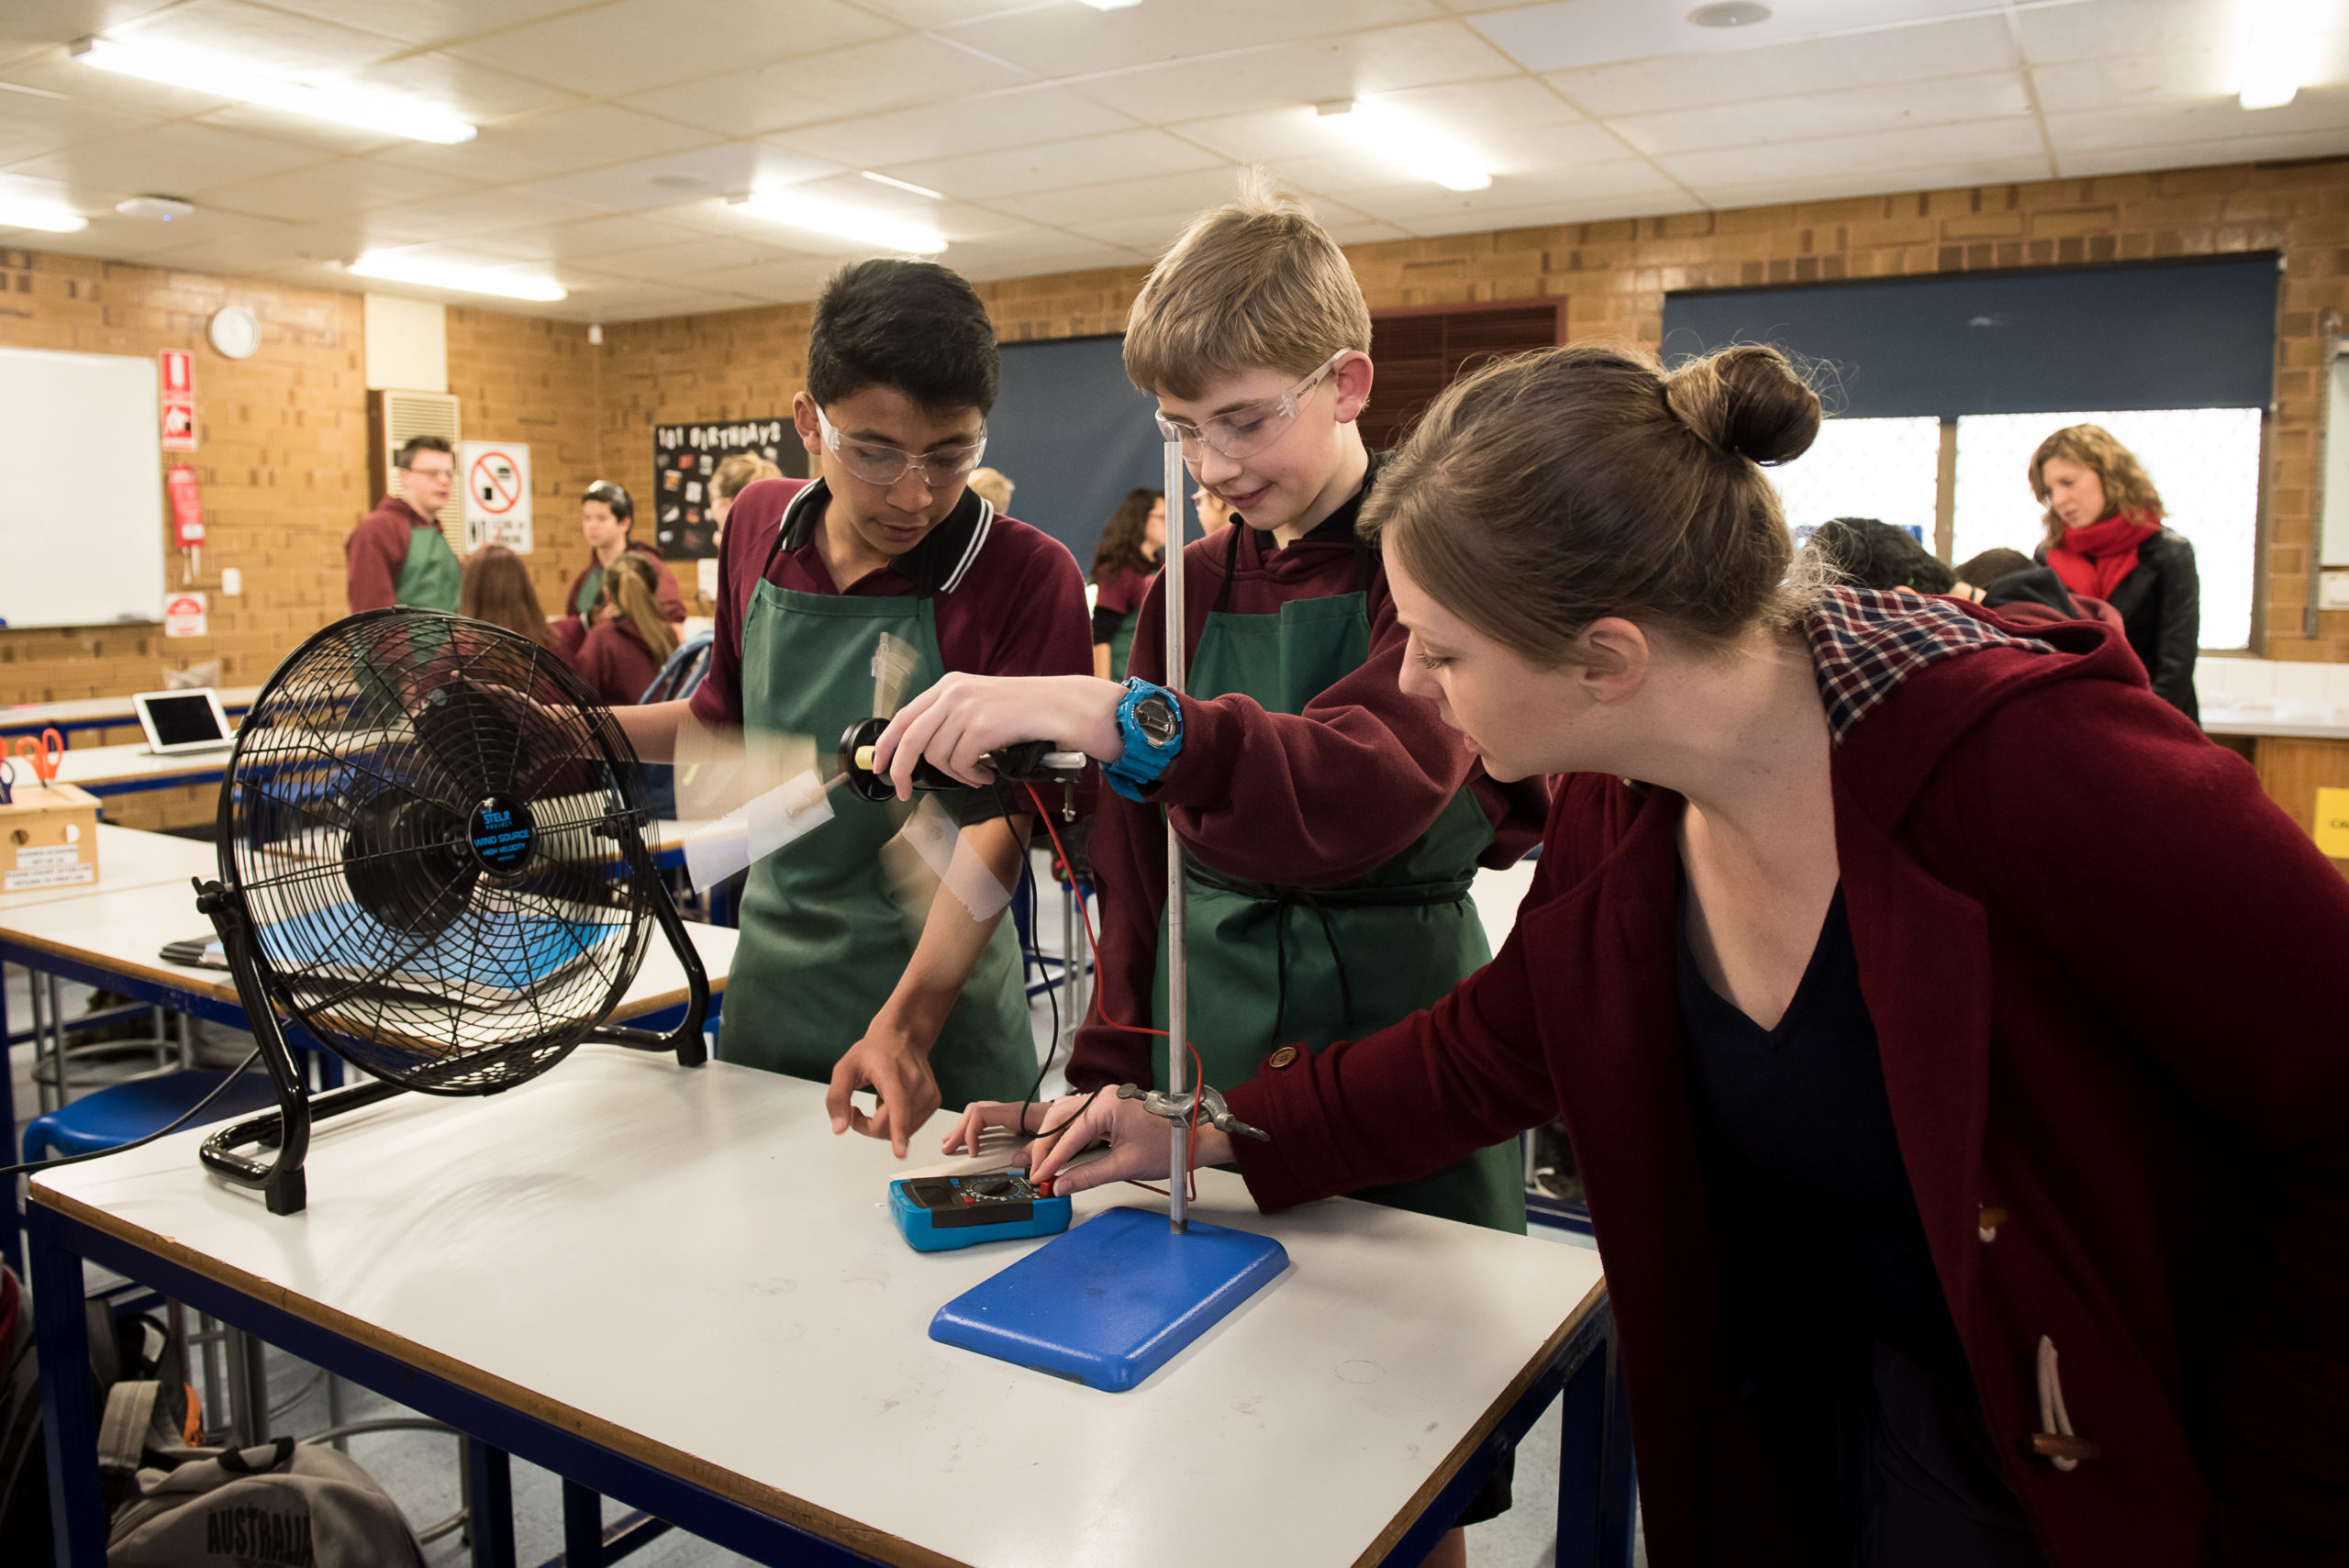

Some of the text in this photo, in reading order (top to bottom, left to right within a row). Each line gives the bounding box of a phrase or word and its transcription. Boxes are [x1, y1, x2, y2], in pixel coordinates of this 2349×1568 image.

[689, 421, 780, 451] BIRTHDAYS
[484, 811, 510, 824] STELR
[473, 829, 529, 847] WIND SOURCE
[499, 843, 526, 853] VELOCITY
[207, 1507, 313, 1567] AUSTRALIA
